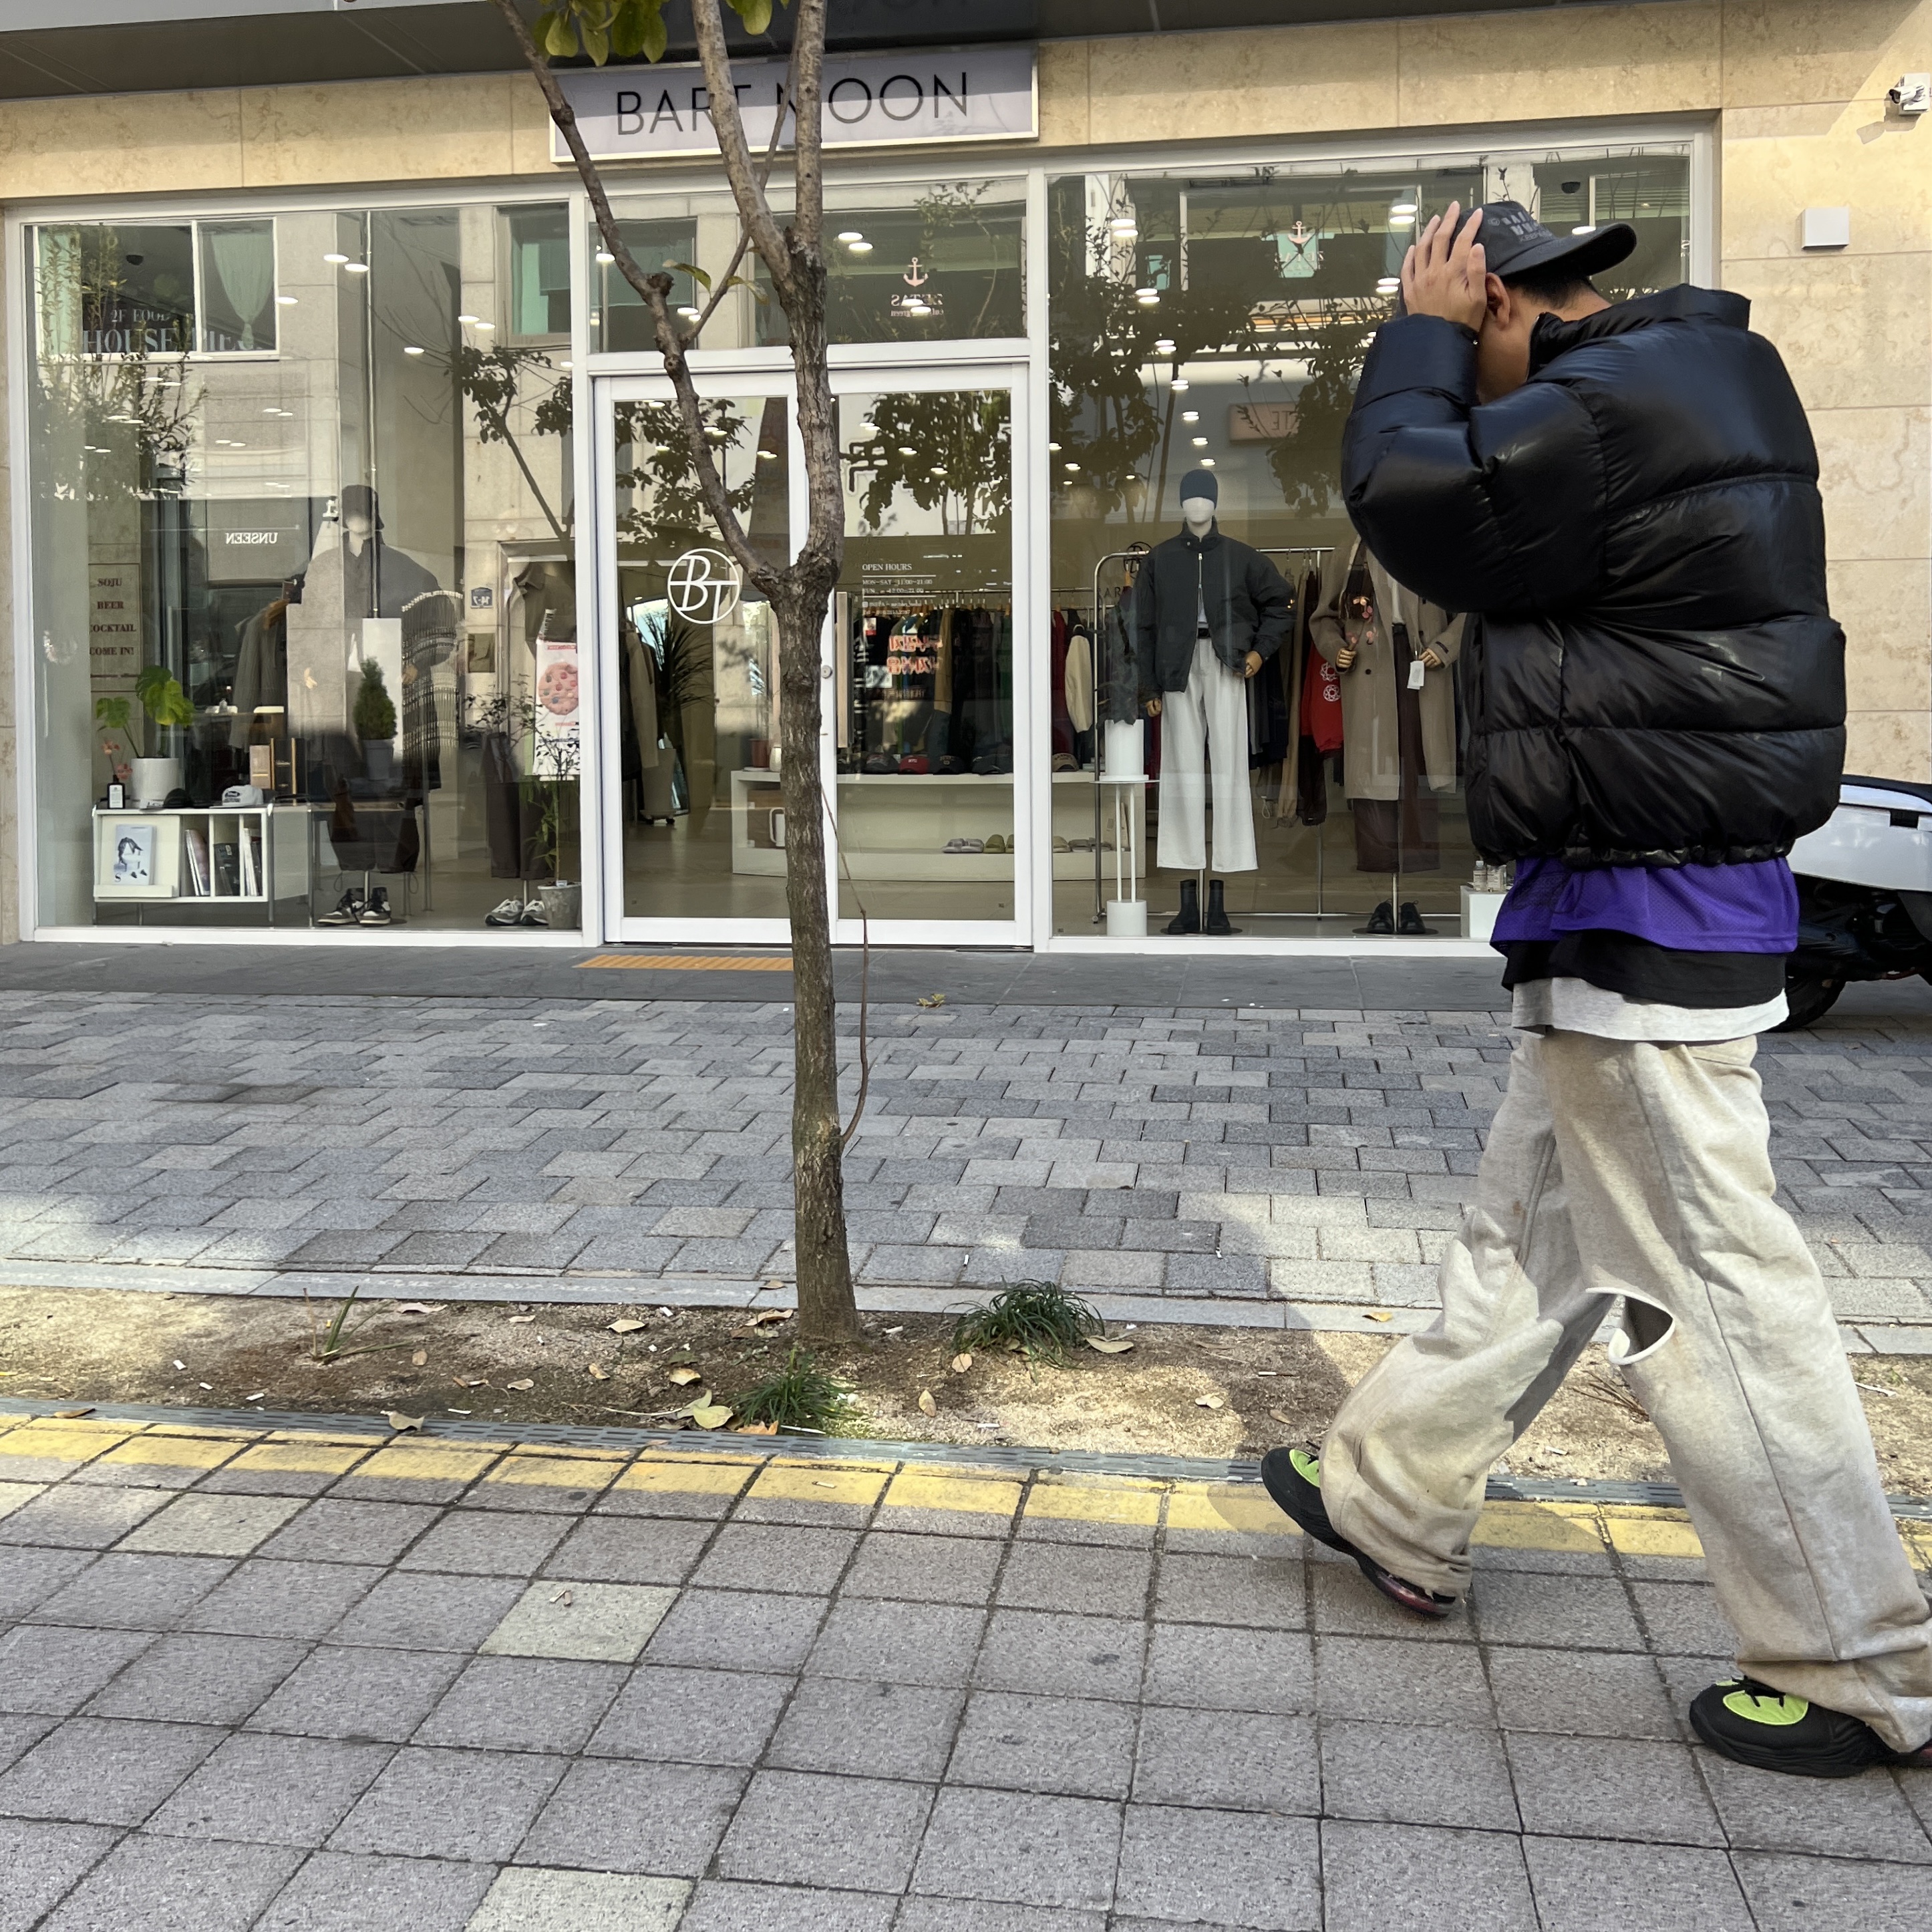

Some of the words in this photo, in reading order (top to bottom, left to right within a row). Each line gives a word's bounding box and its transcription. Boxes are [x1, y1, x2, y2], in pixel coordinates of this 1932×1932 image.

[862, 563, 884, 571] OPEN
[885, 563, 913, 571] HOURS
[97, 577, 122, 587] SOJU
[97, 601, 124, 610] BEER
